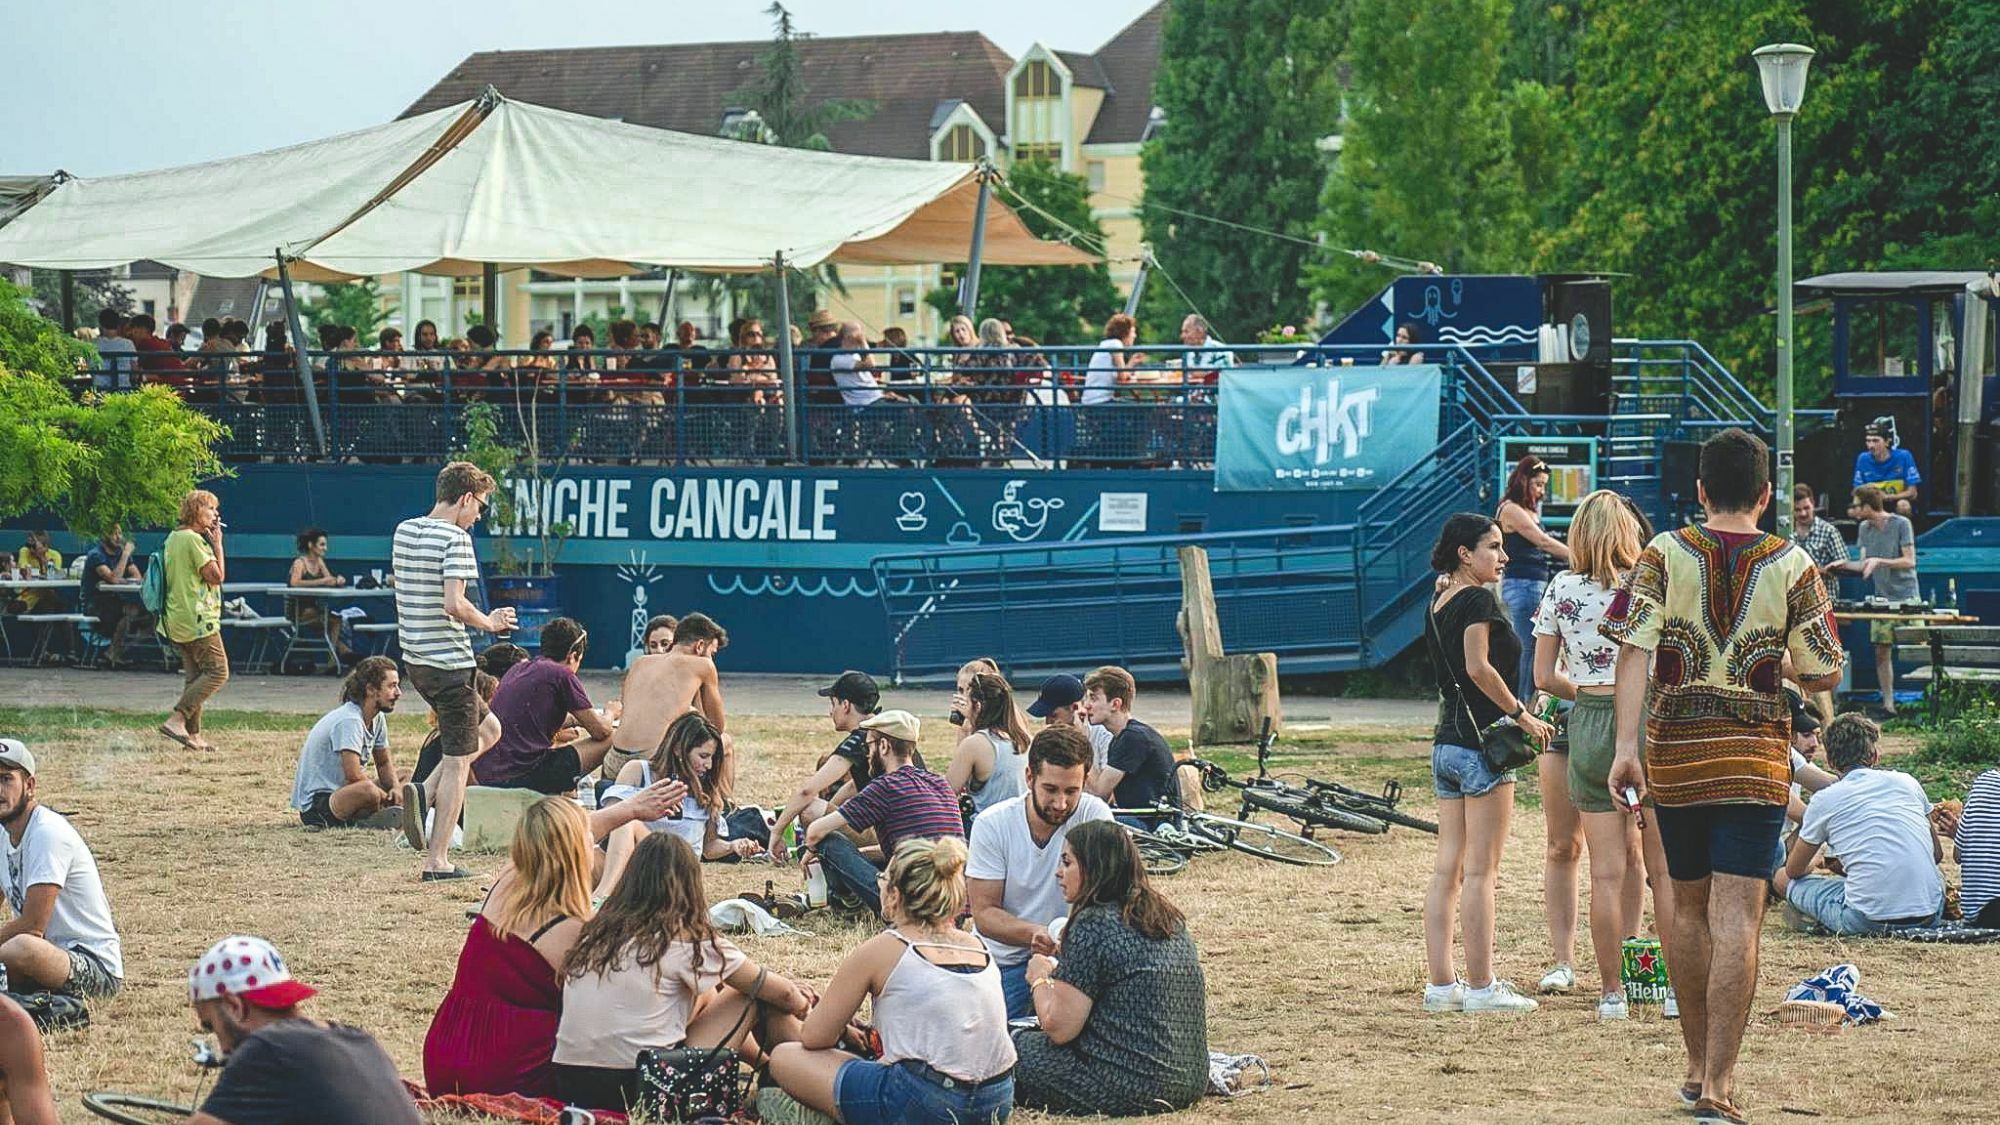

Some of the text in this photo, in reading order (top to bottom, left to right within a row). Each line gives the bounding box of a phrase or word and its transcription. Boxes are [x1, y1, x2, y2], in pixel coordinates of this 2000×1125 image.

[1276, 377, 1379, 466] CHKT
[650, 477, 839, 540] CANCALE
[1631, 982, 1668, 1000] Hein
